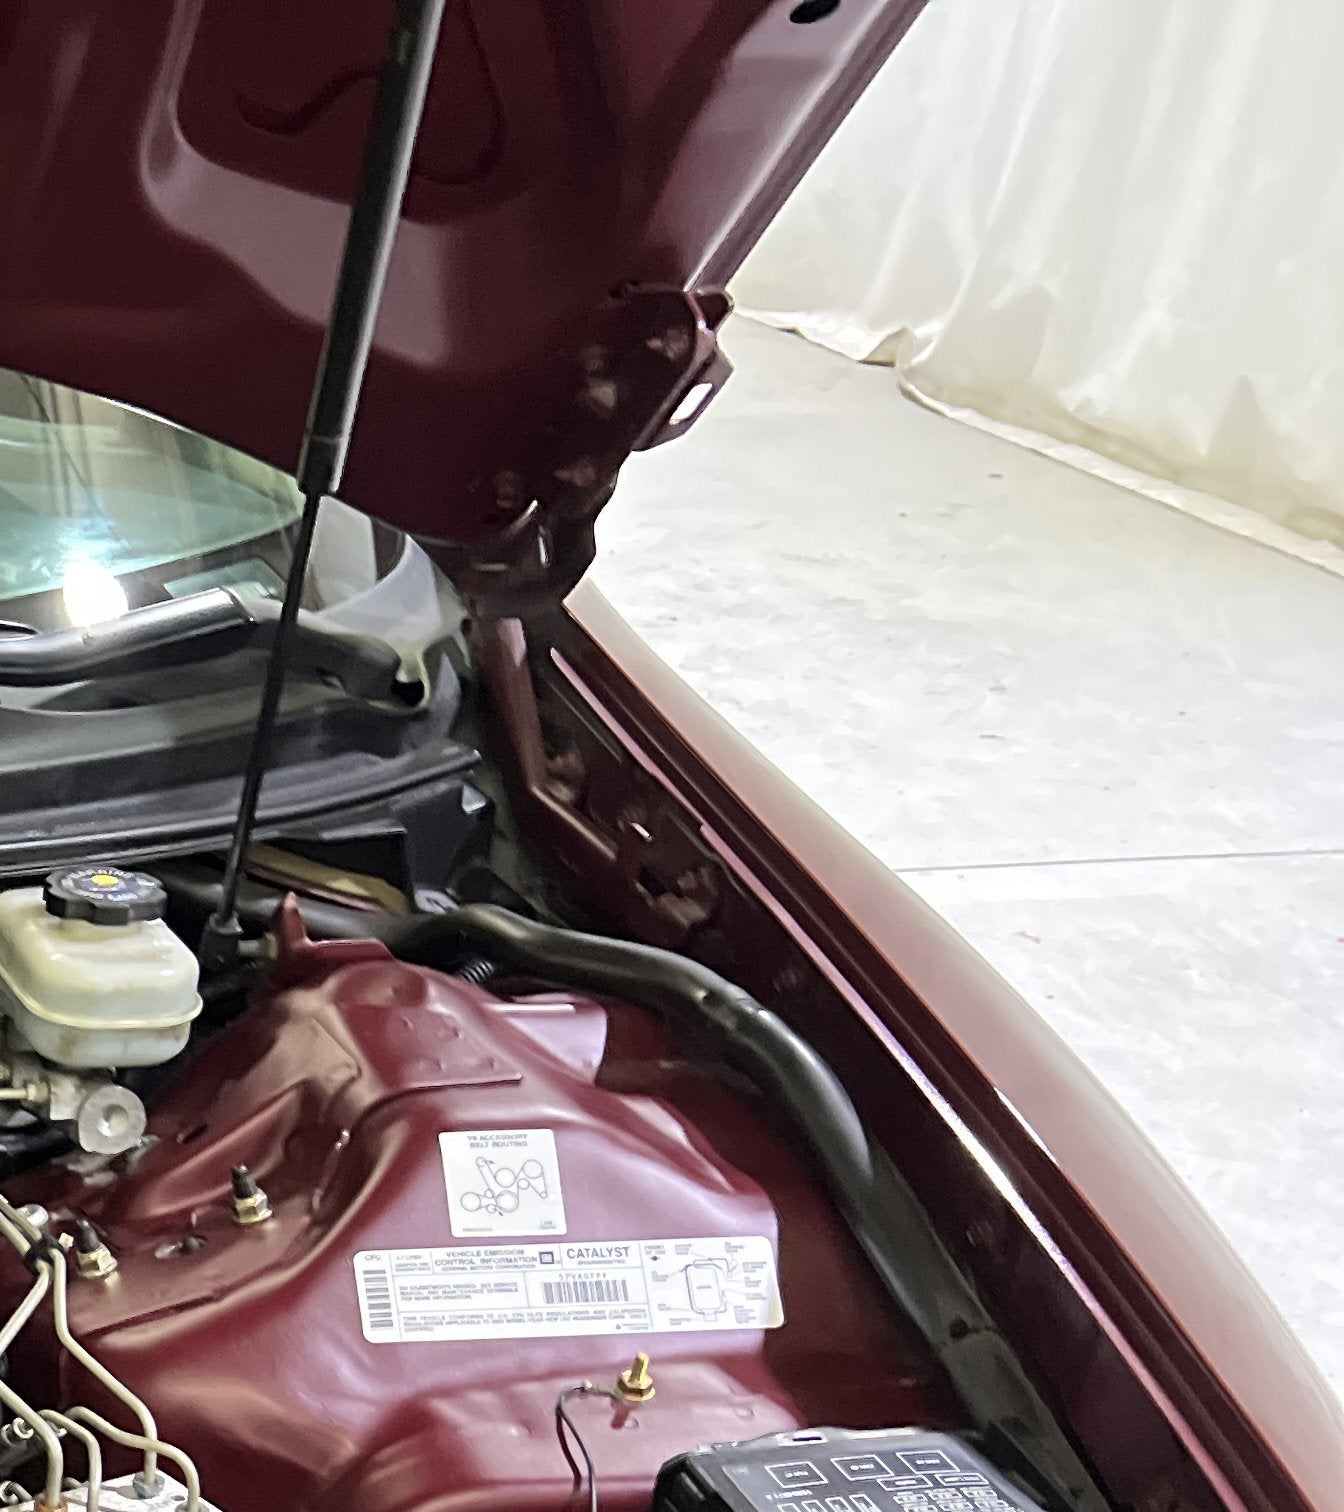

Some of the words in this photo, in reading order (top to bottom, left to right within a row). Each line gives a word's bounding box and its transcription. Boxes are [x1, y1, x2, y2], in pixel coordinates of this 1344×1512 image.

[445, 1249, 481, 1258] VEHICLE
[565, 1246, 631, 1259] CATALYST
[434, 1257, 475, 1266] CONTROL
[479, 1255, 538, 1265] INFORMATION
